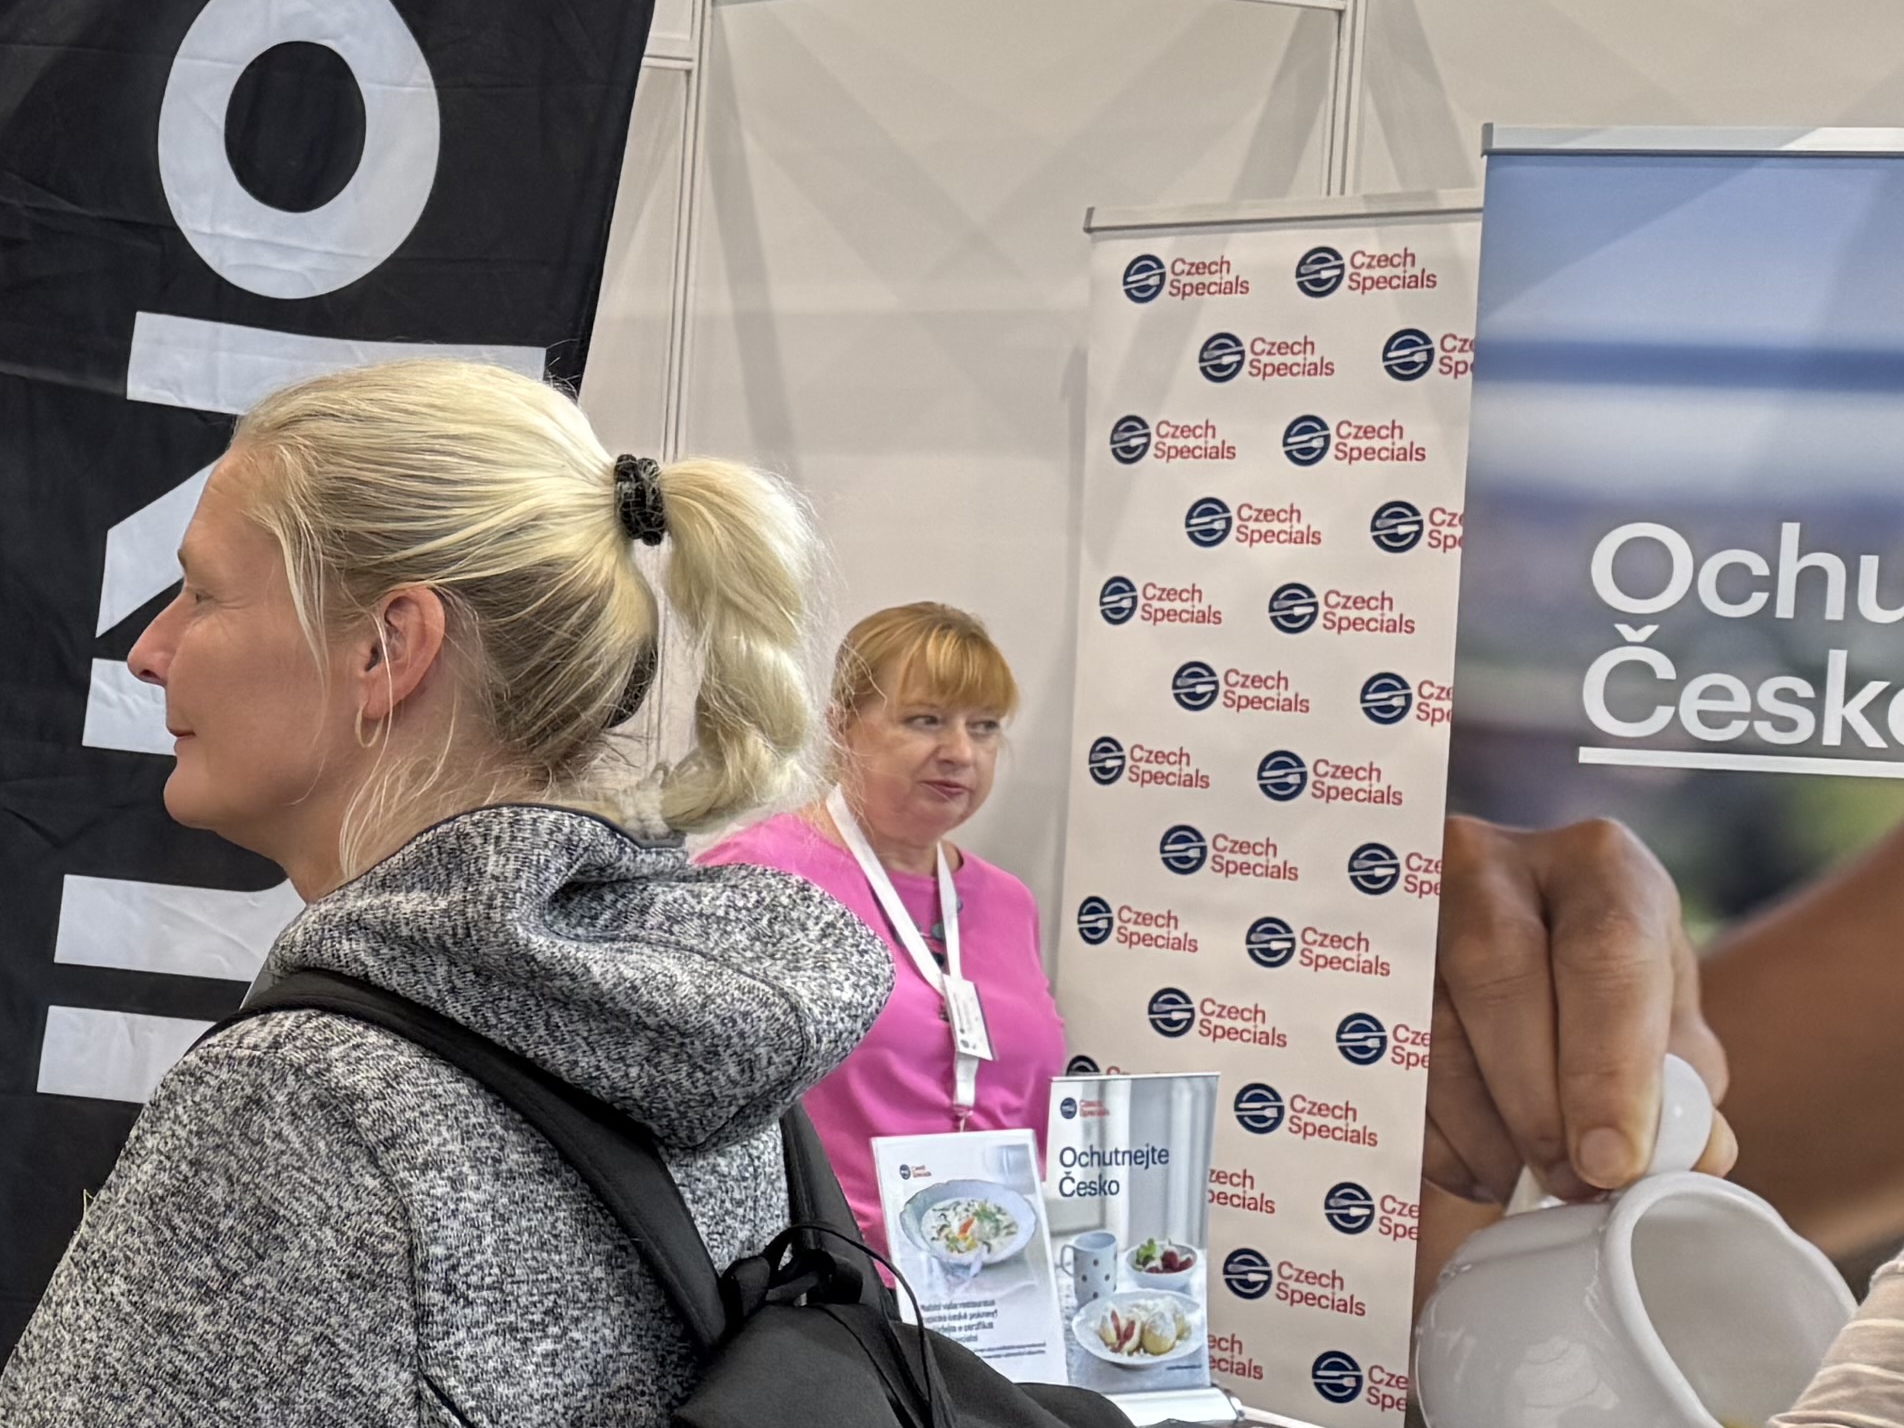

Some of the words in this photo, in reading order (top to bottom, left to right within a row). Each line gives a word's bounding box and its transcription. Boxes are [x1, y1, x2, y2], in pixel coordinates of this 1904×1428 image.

[1171, 256, 1231, 277] Czech
[1350, 247, 1416, 270] Czech
[1168, 277, 1249, 300] Specials
[1348, 268, 1437, 295] Specials
[1250, 336, 1315, 356] Czech
[1248, 357, 1335, 380] Specials
[1156, 420, 1216, 440] Czech
[1335, 420, 1403, 440] Czech
[1154, 440, 1236, 463] Specials
[1334, 441, 1426, 466] Specials
[1237, 503, 1301, 524] Czech
[1235, 524, 1322, 548] Specials
[1142, 583, 1202, 603] Czech
[1323, 590, 1393, 612] Czech
[1140, 604, 1222, 626] Specials
[1322, 612, 1415, 635] Specials
[1224, 669, 1289, 691] Czech
[1582, 623, 1904, 749] Česk
[1222, 690, 1310, 715] Specials
[1129, 744, 1190, 767] Czech
[1128, 765, 1210, 790] Specials
[1312, 759, 1382, 783] Czech
[1311, 780, 1403, 807] Specials
[1212, 833, 1277, 857] Czech
[1210, 855, 1299, 882] Specials
[1117, 905, 1178, 930] Czech
[1116, 926, 1199, 953] Specials
[1300, 926, 1369, 953] Czech
[1299, 949, 1391, 978] Specials
[1200, 997, 1266, 1024] Czech
[1198, 1019, 1288, 1049] Specials
[1290, 1094, 1357, 1122] Czech
[1288, 1116, 1379, 1148] Specials
[1059, 1143, 1170, 1170] Ochutnejte
[1058, 1171, 1120, 1198] Česko
[1277, 1261, 1344, 1291] Czech
[1275, 1282, 1367, 1317] Specials
